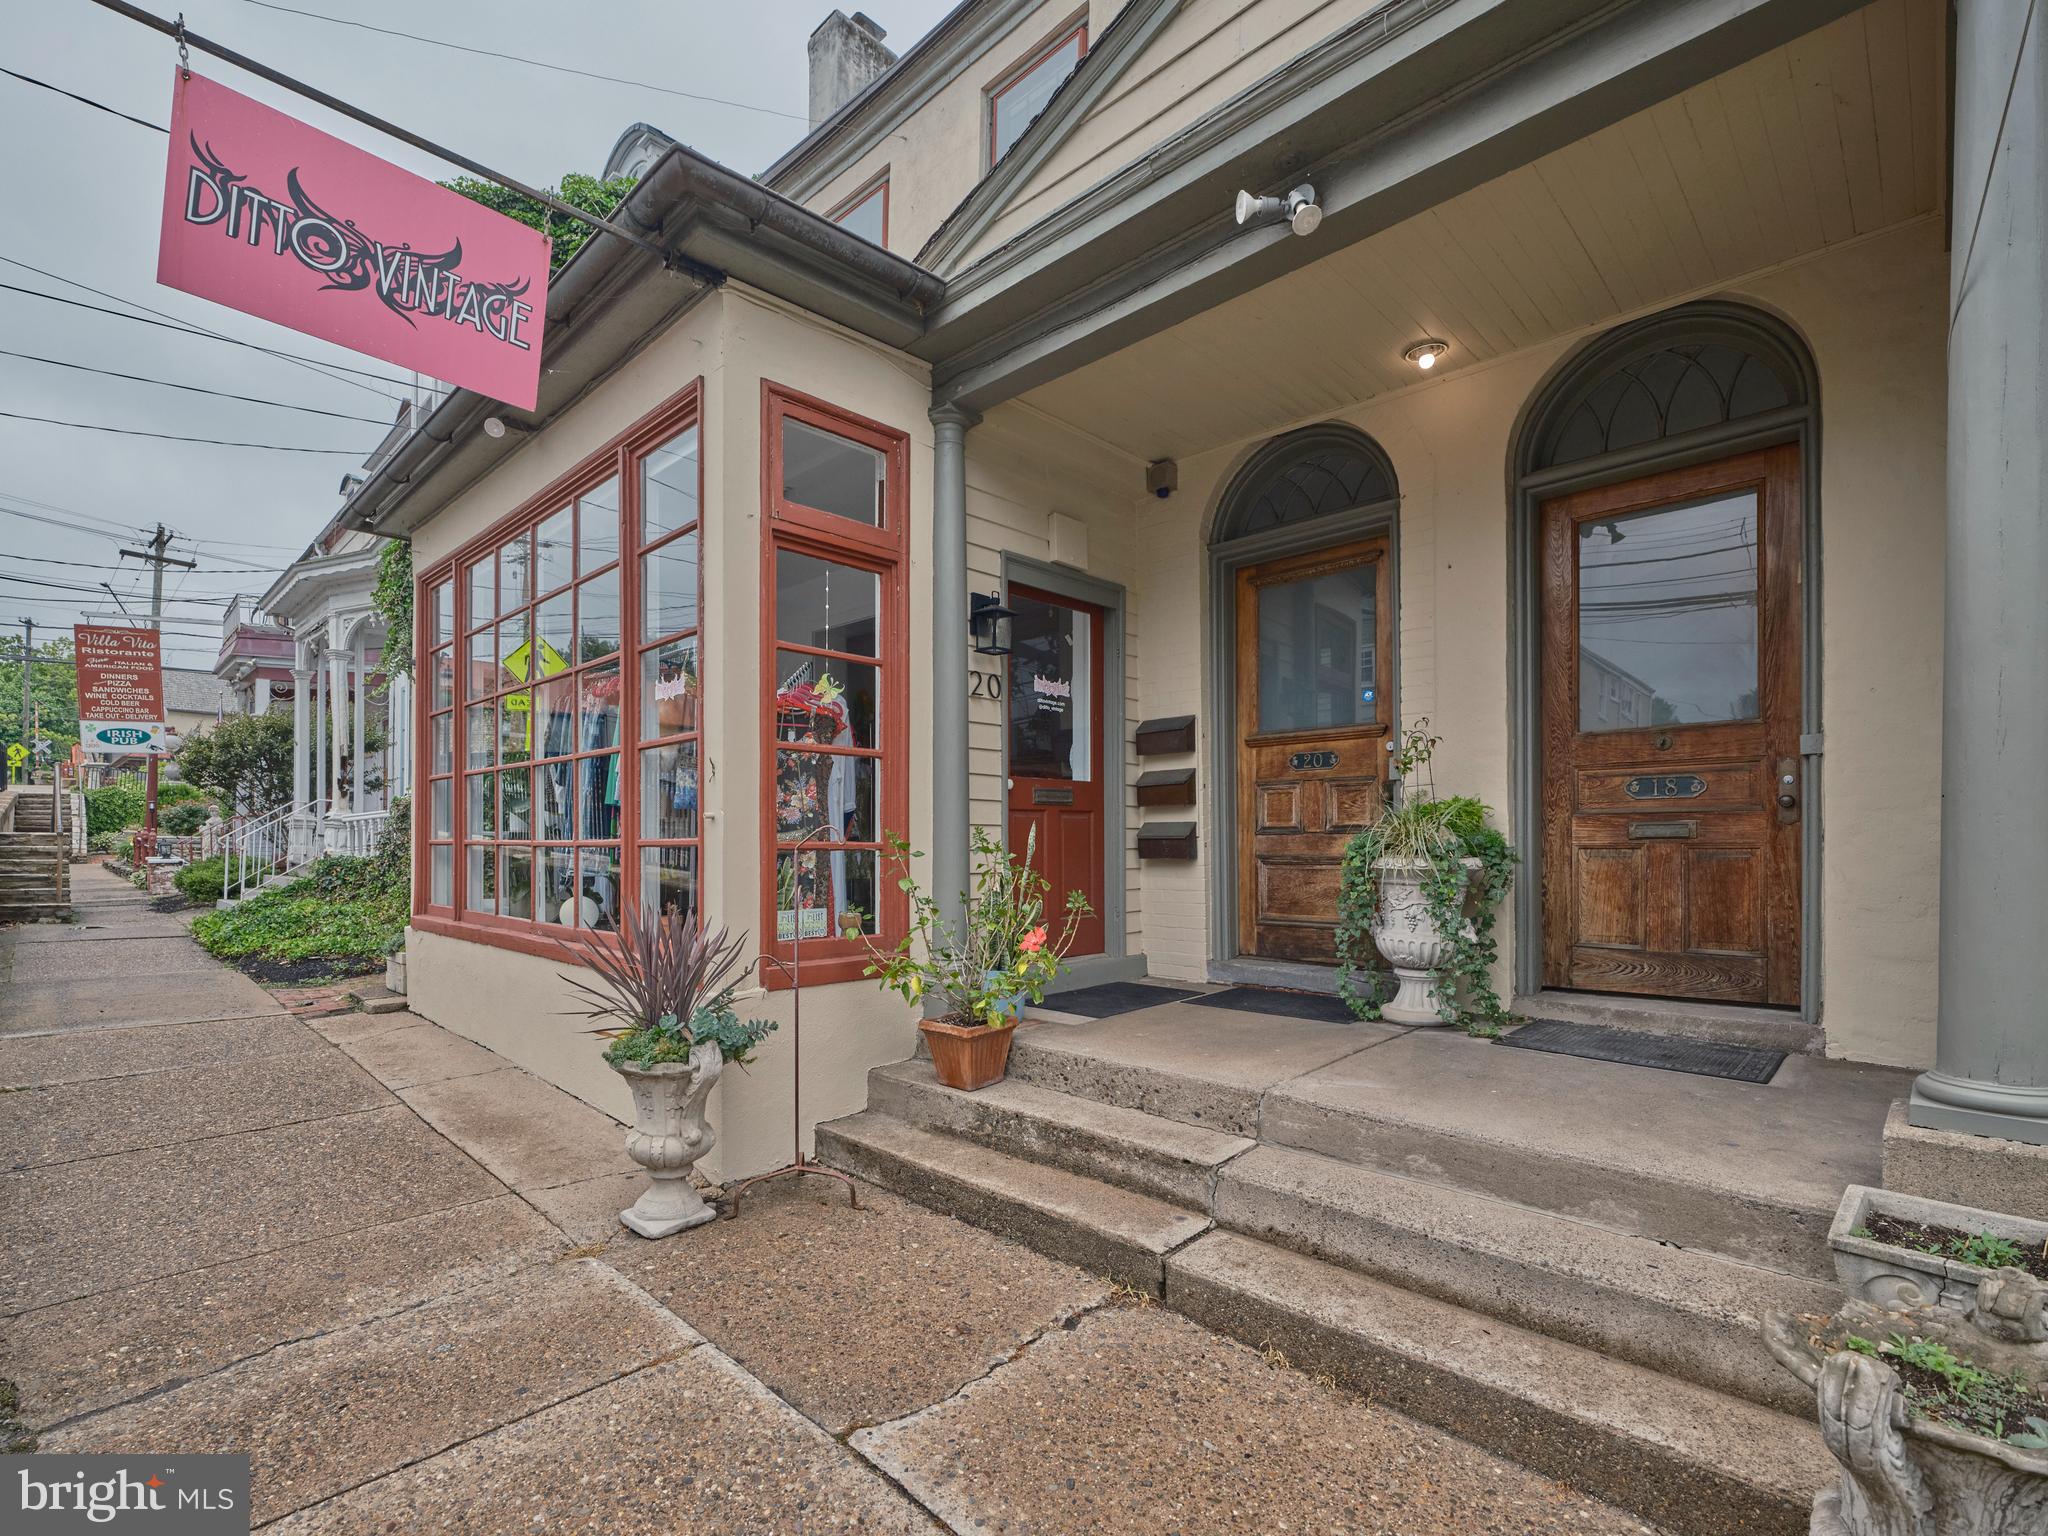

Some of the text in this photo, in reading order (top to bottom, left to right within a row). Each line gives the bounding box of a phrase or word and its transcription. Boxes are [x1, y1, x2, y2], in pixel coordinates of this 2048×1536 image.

[184, 163, 533, 351] DITTO VINTAGE
[78, 633, 157, 649] Villa Vito
[81, 646, 154, 657] Ristorante
[92, 686, 150, 694] SANDWICHES
[970, 670, 1001, 699] 20
[111, 693, 154, 701] COCKTAILS
[91, 706, 134, 714] CAPPUCCINO
[106, 729, 143, 738] IRISH
[111, 737, 138, 745] PUB
[1303, 752, 1323, 768] 20
[1652, 777, 1678, 796] 18
